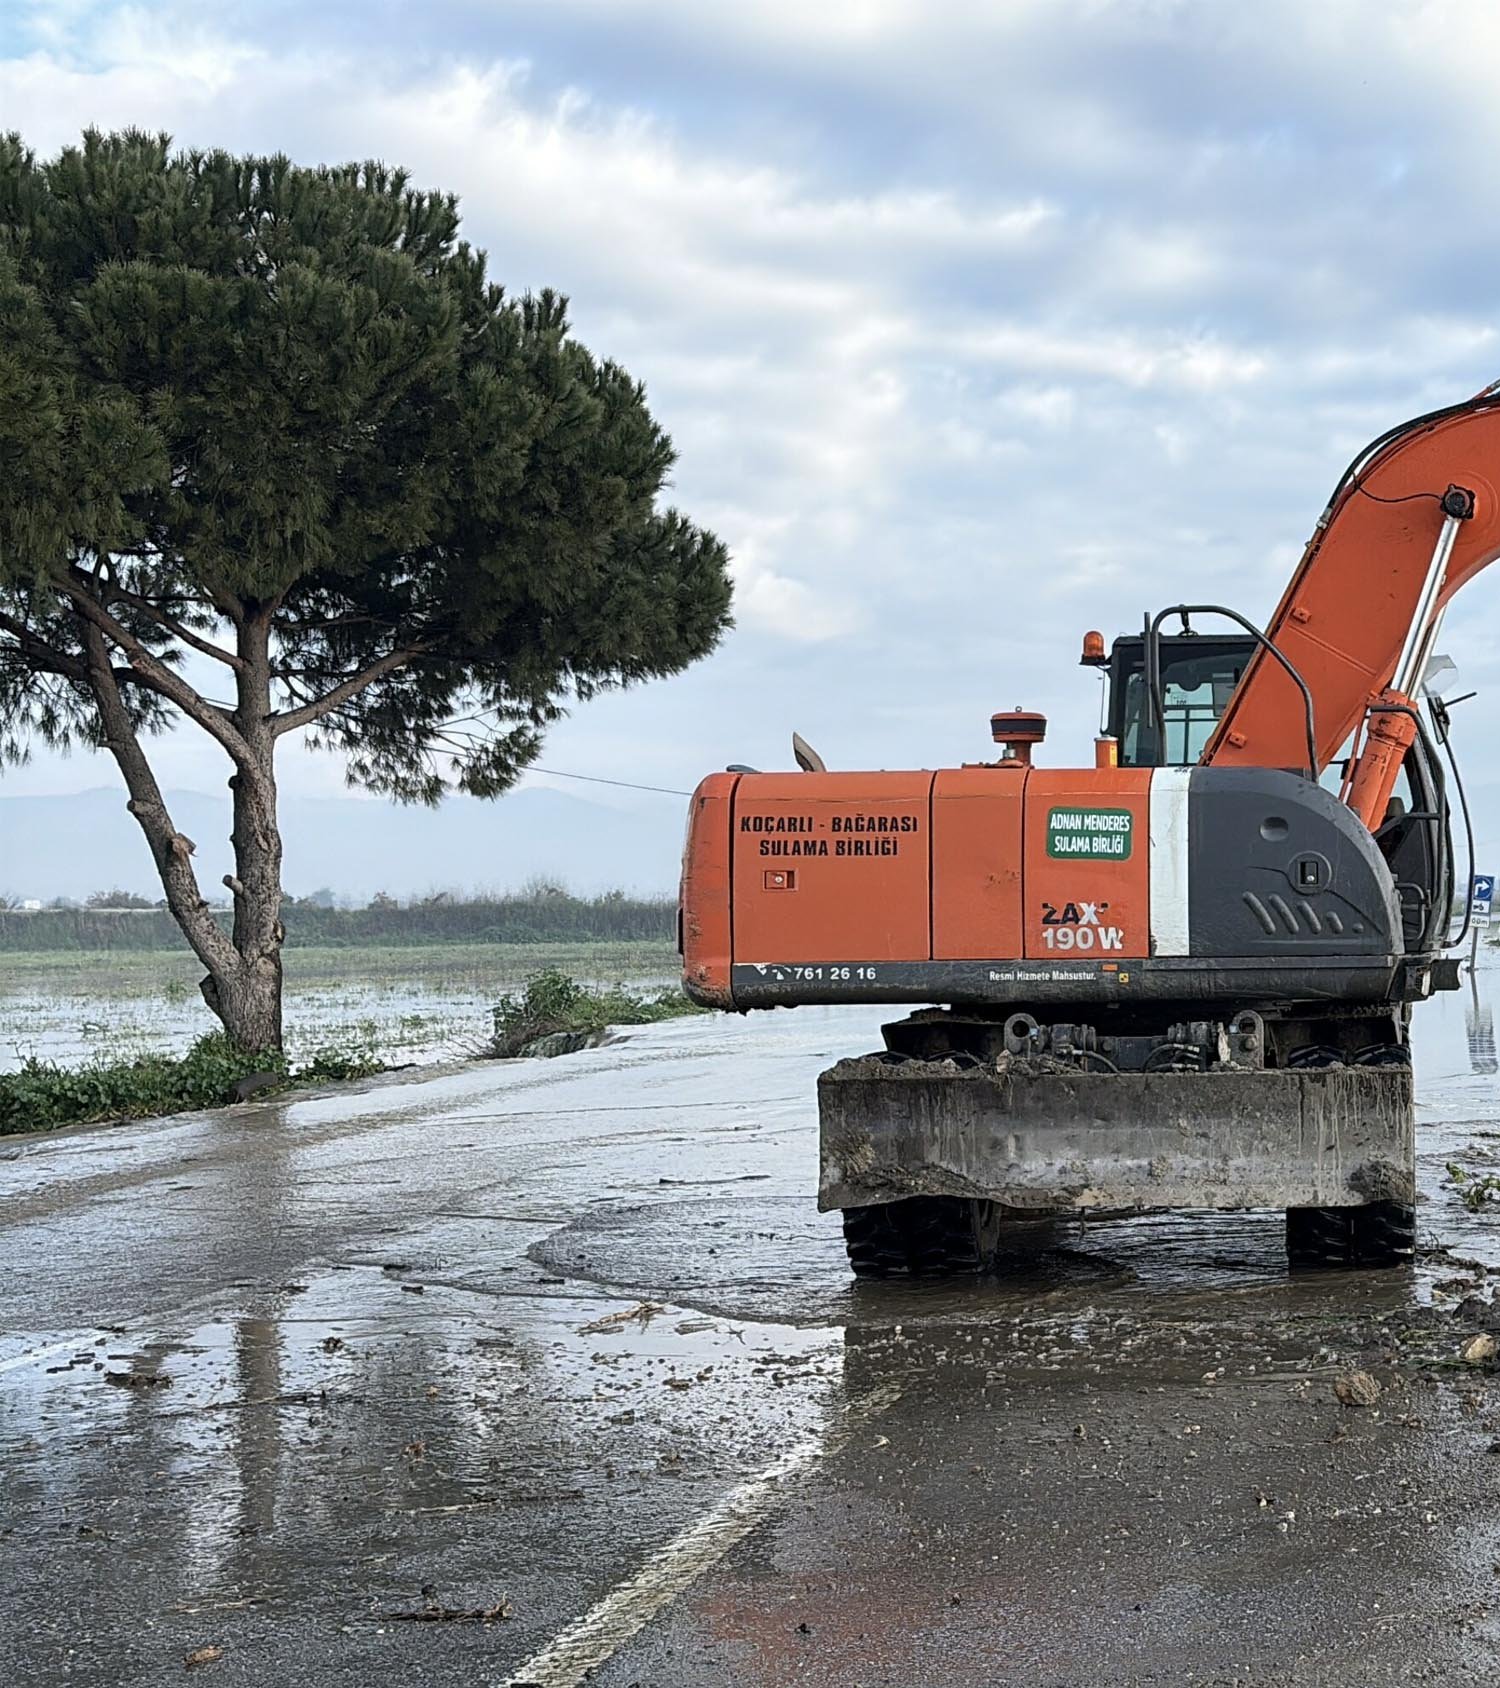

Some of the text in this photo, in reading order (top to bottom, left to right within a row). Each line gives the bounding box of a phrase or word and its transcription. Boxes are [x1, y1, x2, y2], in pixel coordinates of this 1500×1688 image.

[740, 816, 813, 834] KOÇARLI
[831, 813, 918, 832] BAĞARASI
[1050, 813, 1130, 832] ADNAN MENDERES
[759, 837, 898, 856] SULAMA BİRLİĞİ
[1054, 834, 1124, 854] SULAMA BİRLİĞİ
[830, 967, 850, 980] 26
[856, 967, 877, 980] 16
[989, 970, 1015, 981] Resmi
[1016, 970, 1050, 981] Hizmete
